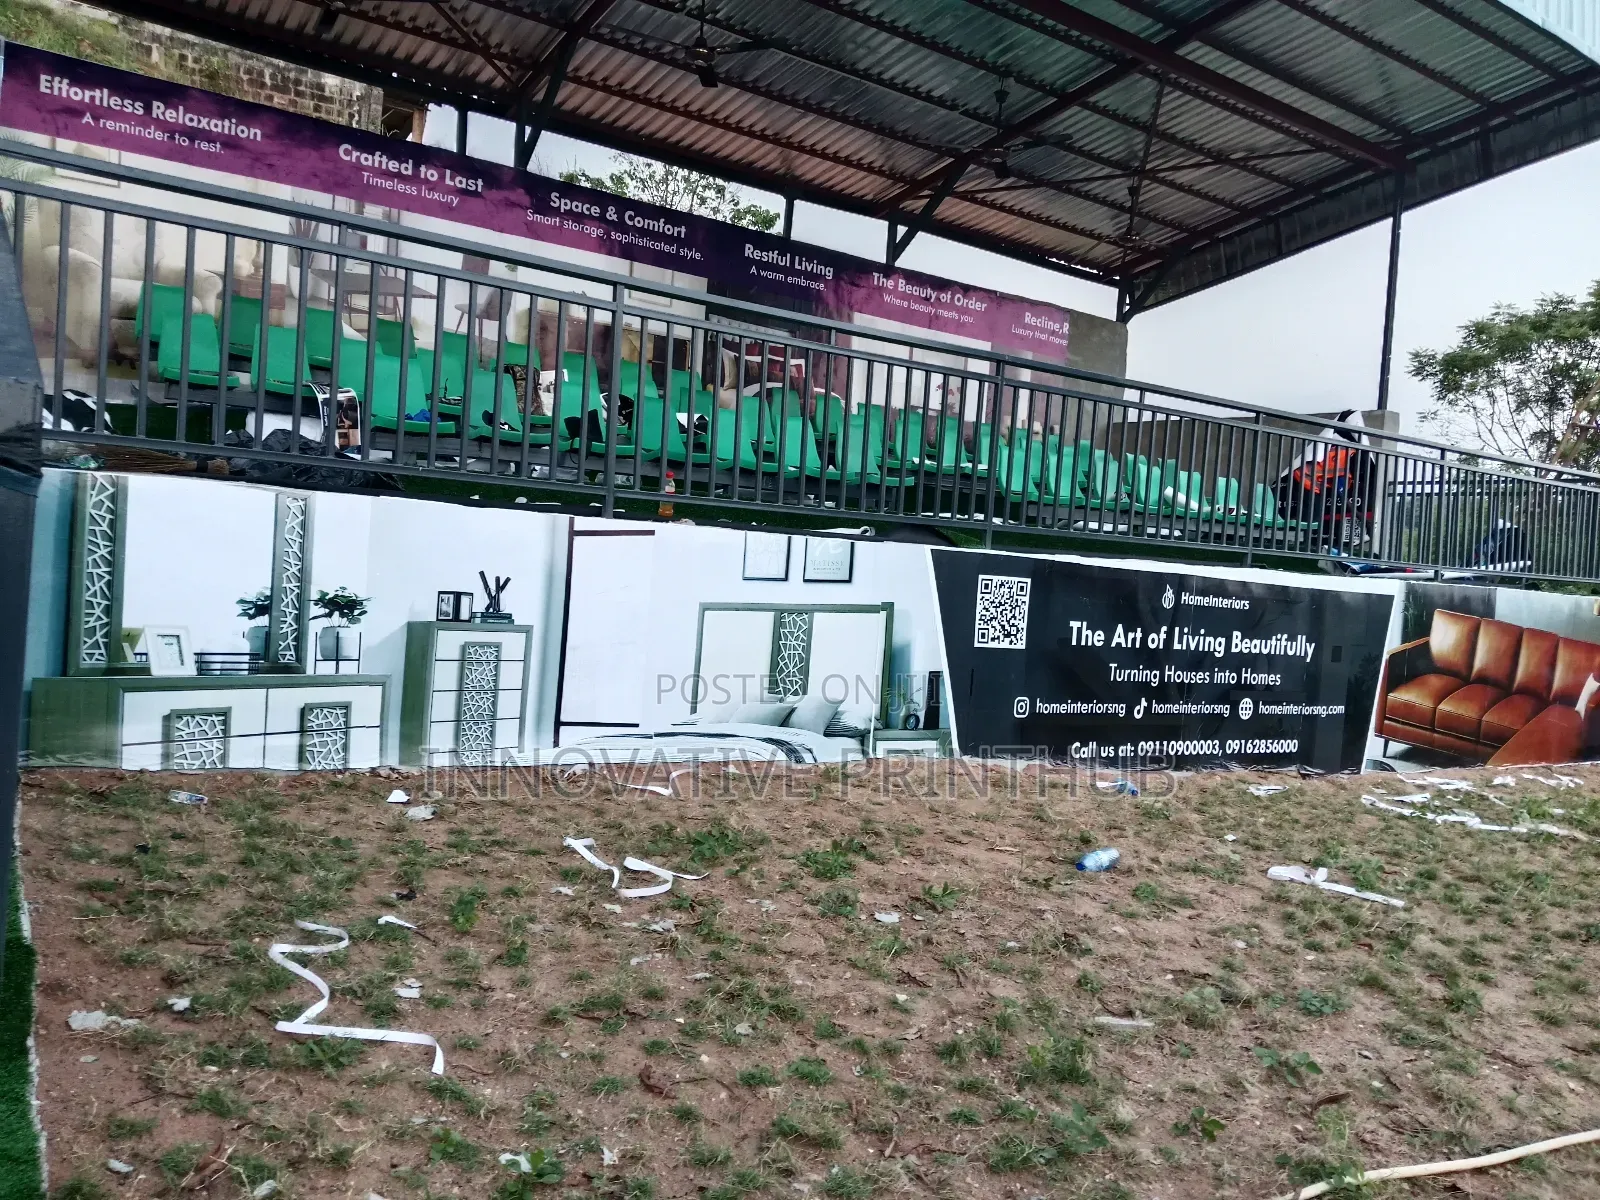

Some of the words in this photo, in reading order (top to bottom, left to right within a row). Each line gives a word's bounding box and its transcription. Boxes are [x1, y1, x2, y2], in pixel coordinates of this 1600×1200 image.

[39, 73, 144, 115] Effortless
[152, 100, 262, 141] Relaxation
[82, 112, 95, 126] A
[100, 117, 170, 142] reminder
[175, 132, 189, 146] to
[195, 139, 225, 154] rest.
[338, 143, 413, 176] Crafted
[419, 164, 438, 181] to
[445, 169, 484, 192] Last
[361, 171, 417, 195] Timeless
[421, 186, 459, 207] luxury
[550, 191, 601, 217] Space
[606, 205, 619, 222] &
[624, 210, 687, 238] Comfort
[526, 209, 560, 227] Smart
[563, 219, 607, 239] storage,
[610, 231, 677, 254] sophisticated
[679, 247, 704, 261] style.
[744, 243, 790, 267] Restful
[795, 256, 834, 279] Living
[750, 265, 758, 275] A
[760, 269, 785, 281] warm
[787, 276, 827, 291] embrace.
[872, 272, 894, 290] The
[898, 279, 937, 301] Beauty
[940, 291, 952, 303] of
[954, 294, 988, 312] Order
[883, 292, 908, 308] Where
[910, 300, 935, 317] beauty
[937, 308, 959, 320] meets
[1011, 324, 1034, 339] Luxury
[1034, 329, 1048, 340] that
[1181, 591, 1250, 610] HomeInteriors
[1069, 620, 1105, 647] The
[1111, 623, 1142, 649] Art
[1147, 626, 1168, 649] of
[1173, 626, 1226, 658] Living
[1231, 631, 1316, 662] Beautifully
[1109, 663, 1160, 687] Turning
[1164, 665, 1210, 684] Houses
[1214, 667, 1237, 685] into
[1241, 667, 1281, 686] Homes
[1036, 698, 1126, 717] homeinteriorsng
[1151, 699, 1230, 718] homeinteriorsng
[1258, 701, 1345, 718] homeinteriorsng.com
[1071, 741, 1097, 758] Call
[1100, 745, 1115, 757] us
[1118, 742, 1135, 757] at:
[1138, 739, 1223, 757] 09110900003,
[1225, 739, 1299, 754] 09162856000
